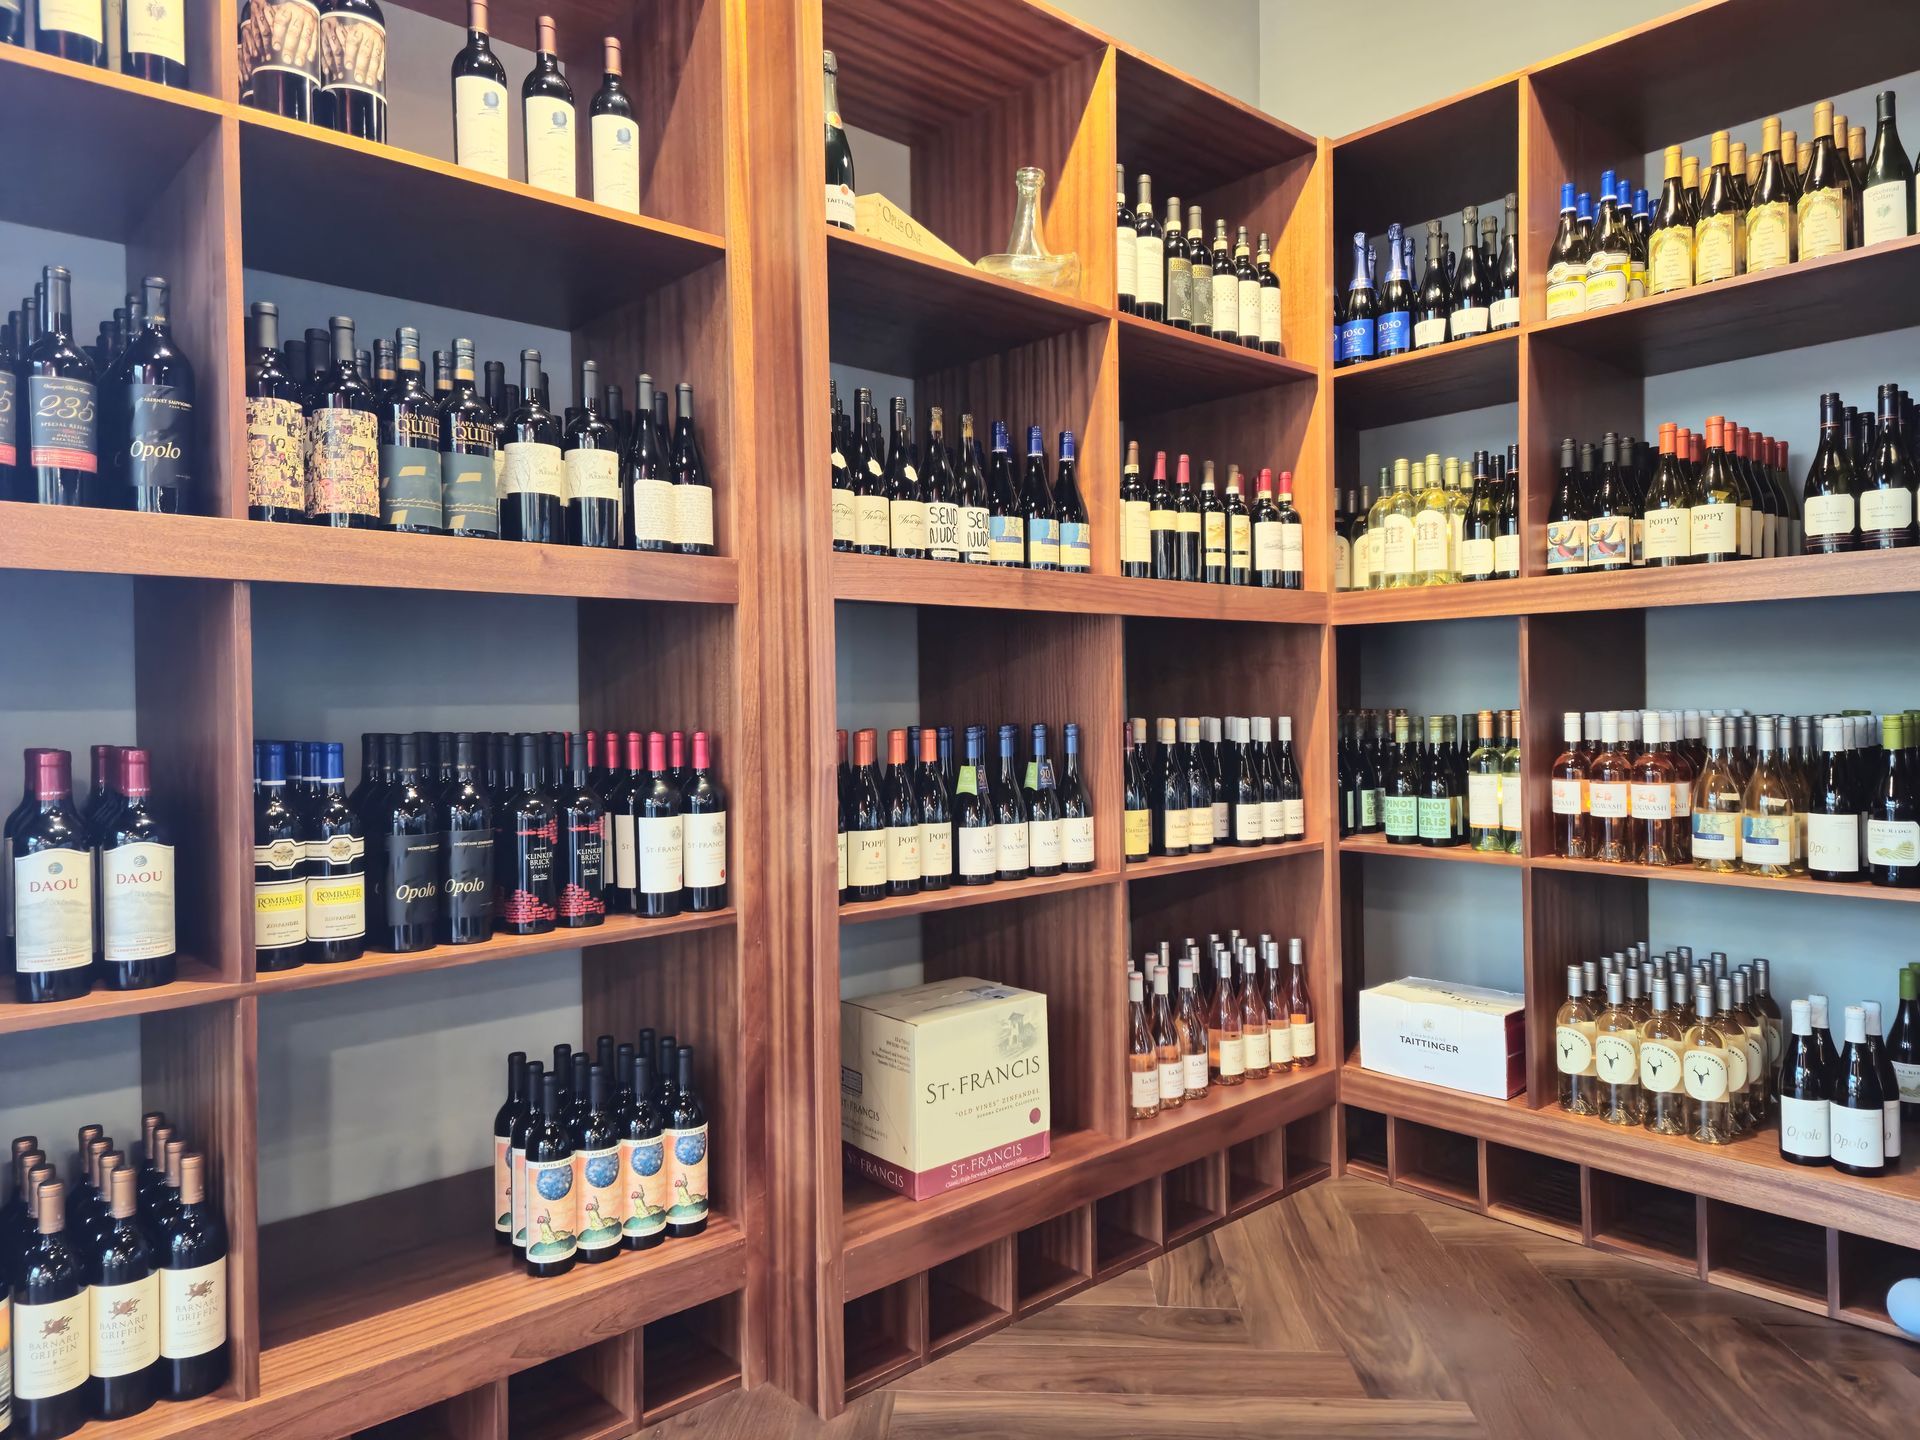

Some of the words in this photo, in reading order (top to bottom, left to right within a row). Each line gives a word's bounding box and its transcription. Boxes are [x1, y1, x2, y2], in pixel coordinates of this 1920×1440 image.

[827, 197, 855, 209] TAITTING
[1379, 319, 1402, 331] TOSO
[1343, 327, 1366, 339] TOSO
[35, 394, 95, 422] 235
[398, 411, 418, 420] NAPA
[130, 440, 182, 463] Opolo
[929, 506, 958, 526] SEND
[1649, 516, 1680, 528] POPPY
[1693, 512, 1724, 524] POPPY
[929, 526, 959, 544] NUDE
[967, 530, 990, 548] NUD
[1386, 815, 1414, 825] GRIS
[699, 840, 723, 849] FRANC
[898, 836, 920, 847] POPP
[929, 832, 950, 843] POPP
[576, 847, 602, 855] KLINKER
[657, 845, 681, 853] FRANC
[861, 840, 886, 851] POPP
[525, 851, 553, 860] KLINKER
[529, 858, 550, 866] BRICK
[581, 853, 600, 861] BRICK
[30, 877, 79, 893] DAOU
[116, 870, 163, 885] DAOU
[395, 882, 436, 904] Opolo
[444, 877, 485, 897] Opolo
[257, 893, 304, 909] ROMBAUER
[316, 888, 362, 902] ROMBAUER
[1399, 1035, 1459, 1054] TAITTINGER
[1728, 1049, 1744, 1063] OWBOYS
[959, 1055, 1040, 1095] FRANCIS
[1001, 1088, 1040, 1104] ZINFANDEL
[971, 1143, 1023, 1171] FRANCIS
[860, 1157, 905, 1188] FRANCIS
[176, 1305, 218, 1322] GRIFFIN
[99, 1313, 149, 1332] BARNARD
[100, 1325, 145, 1340] GRIFFIN
[28, 1332, 80, 1351] BARNARD
[30, 1342, 78, 1361] GRIFFIN
